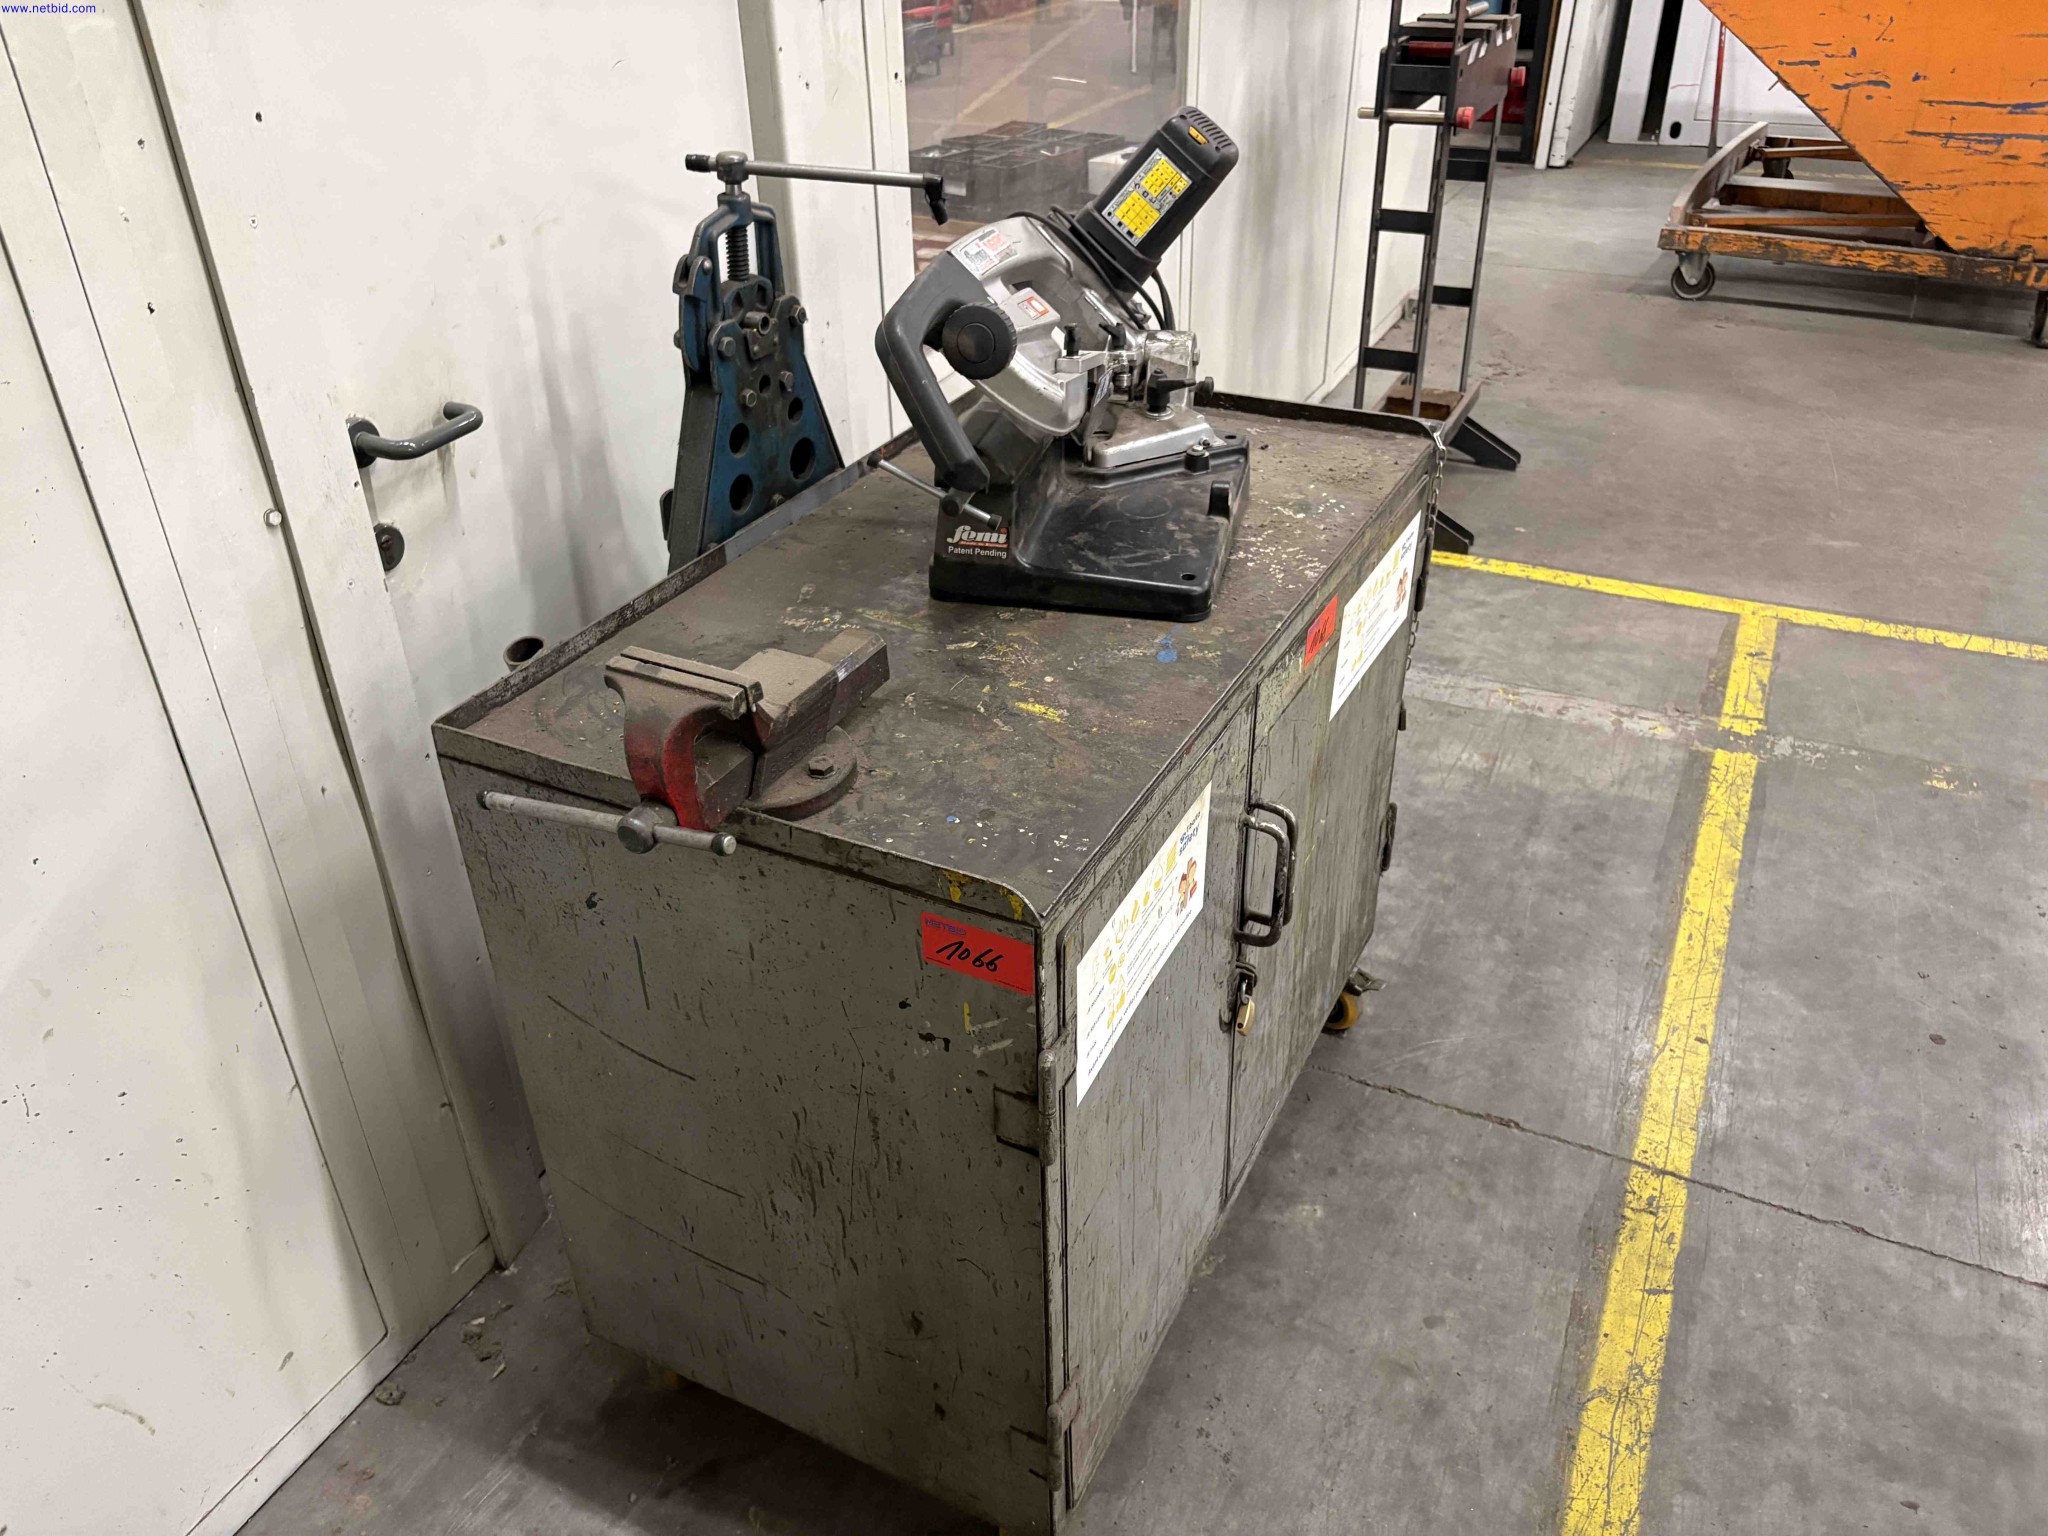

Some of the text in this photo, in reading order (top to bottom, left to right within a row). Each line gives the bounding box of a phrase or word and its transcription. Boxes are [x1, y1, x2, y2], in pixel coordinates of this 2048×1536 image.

[946, 525, 1009, 544] femi
[948, 546, 1007, 559] Patent Pending
[935, 940, 1004, 972] 1066
